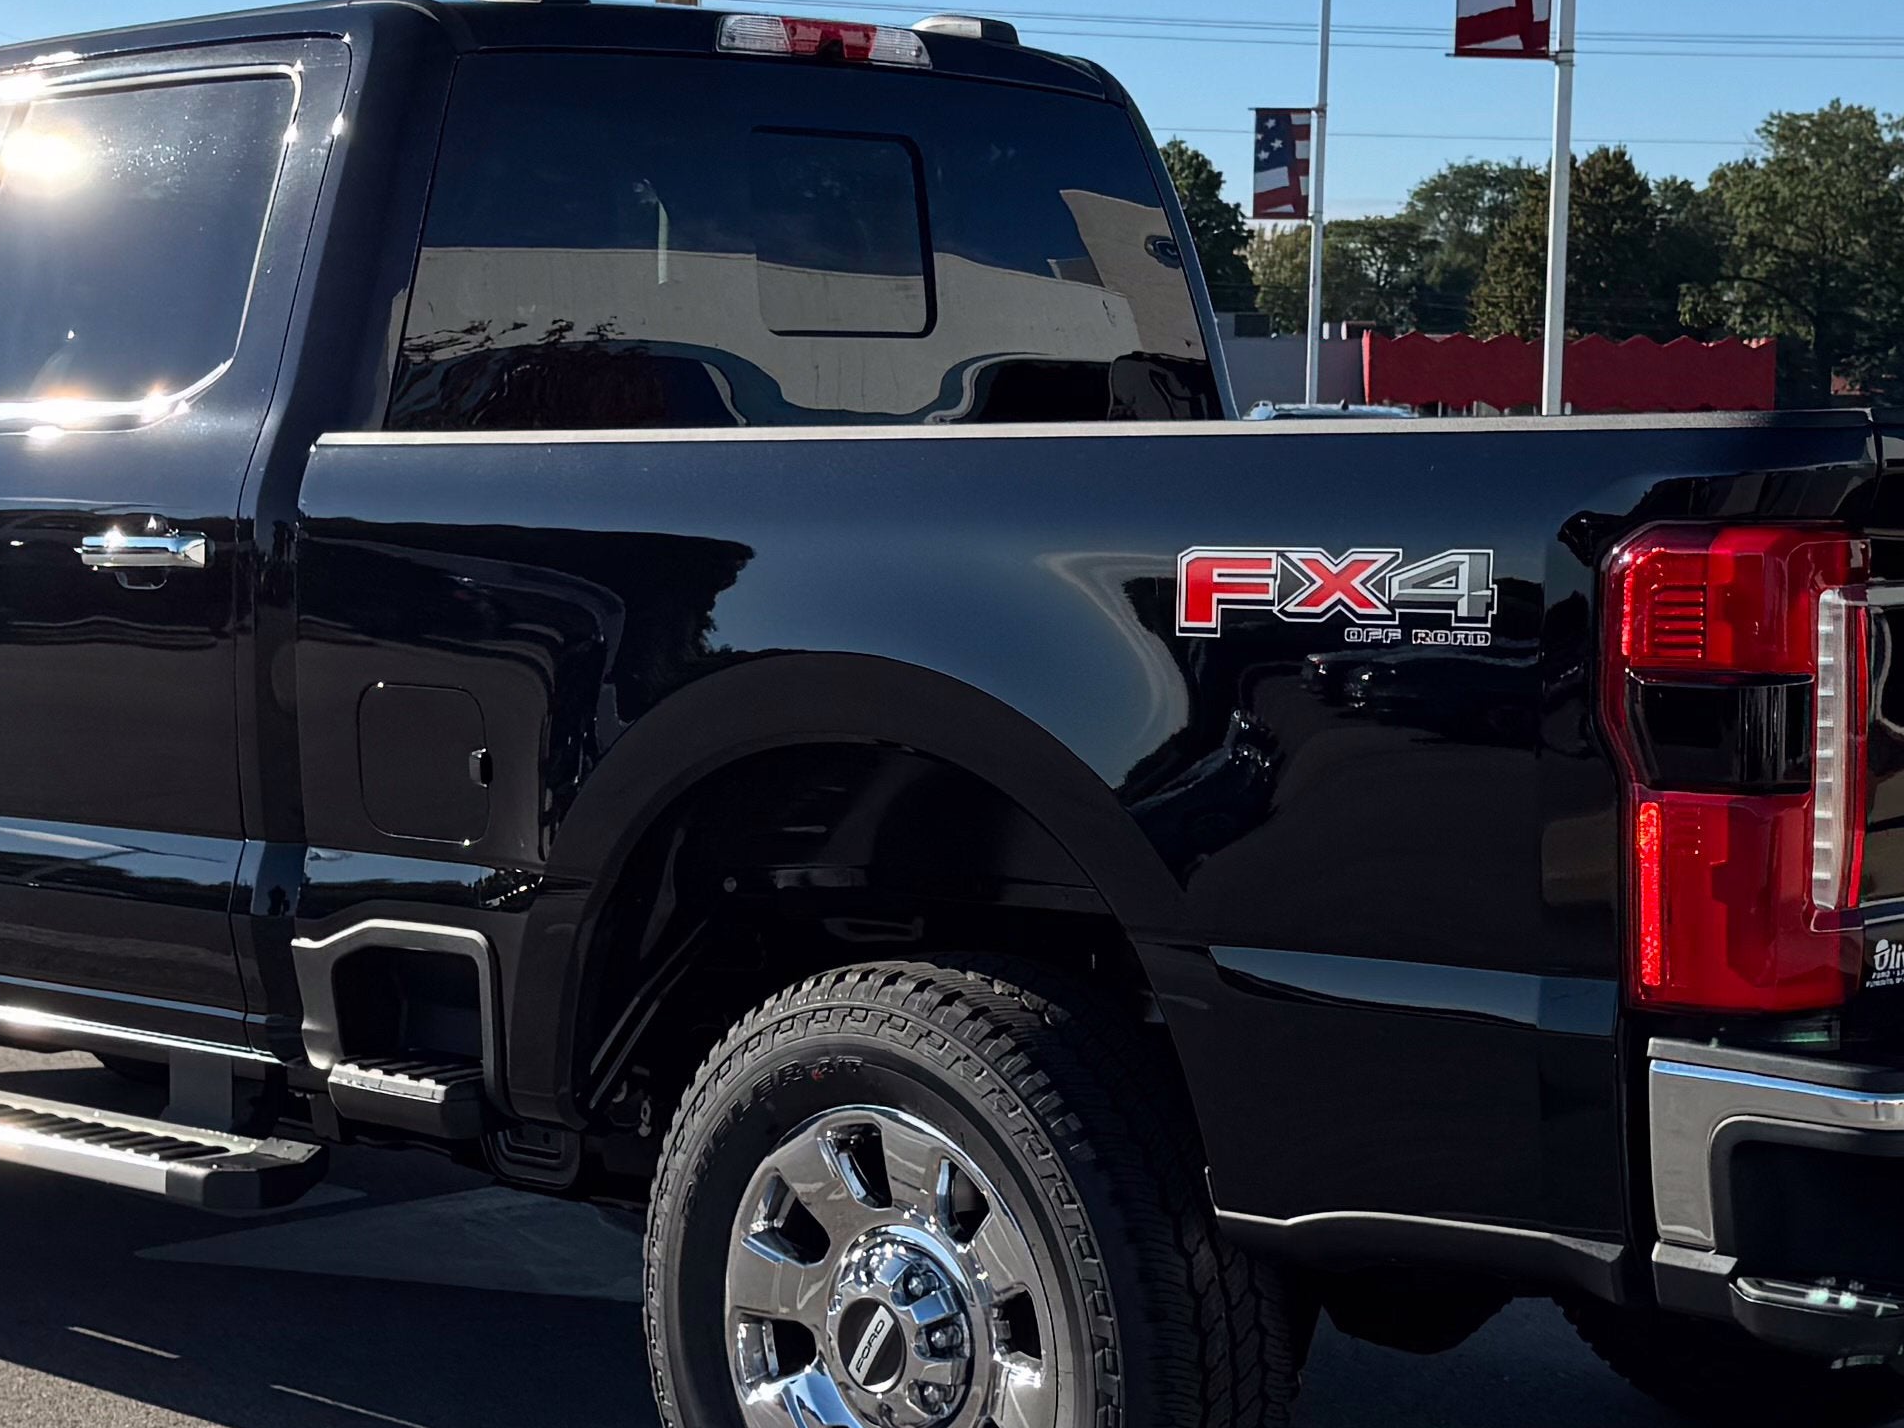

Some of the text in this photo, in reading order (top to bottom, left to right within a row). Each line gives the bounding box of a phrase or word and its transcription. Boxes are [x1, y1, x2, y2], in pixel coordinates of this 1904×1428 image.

[1176, 546, 1497, 637] FX4
[1344, 627, 1492, 646] OFF ROAD
[855, 1319, 886, 1374] FORD
